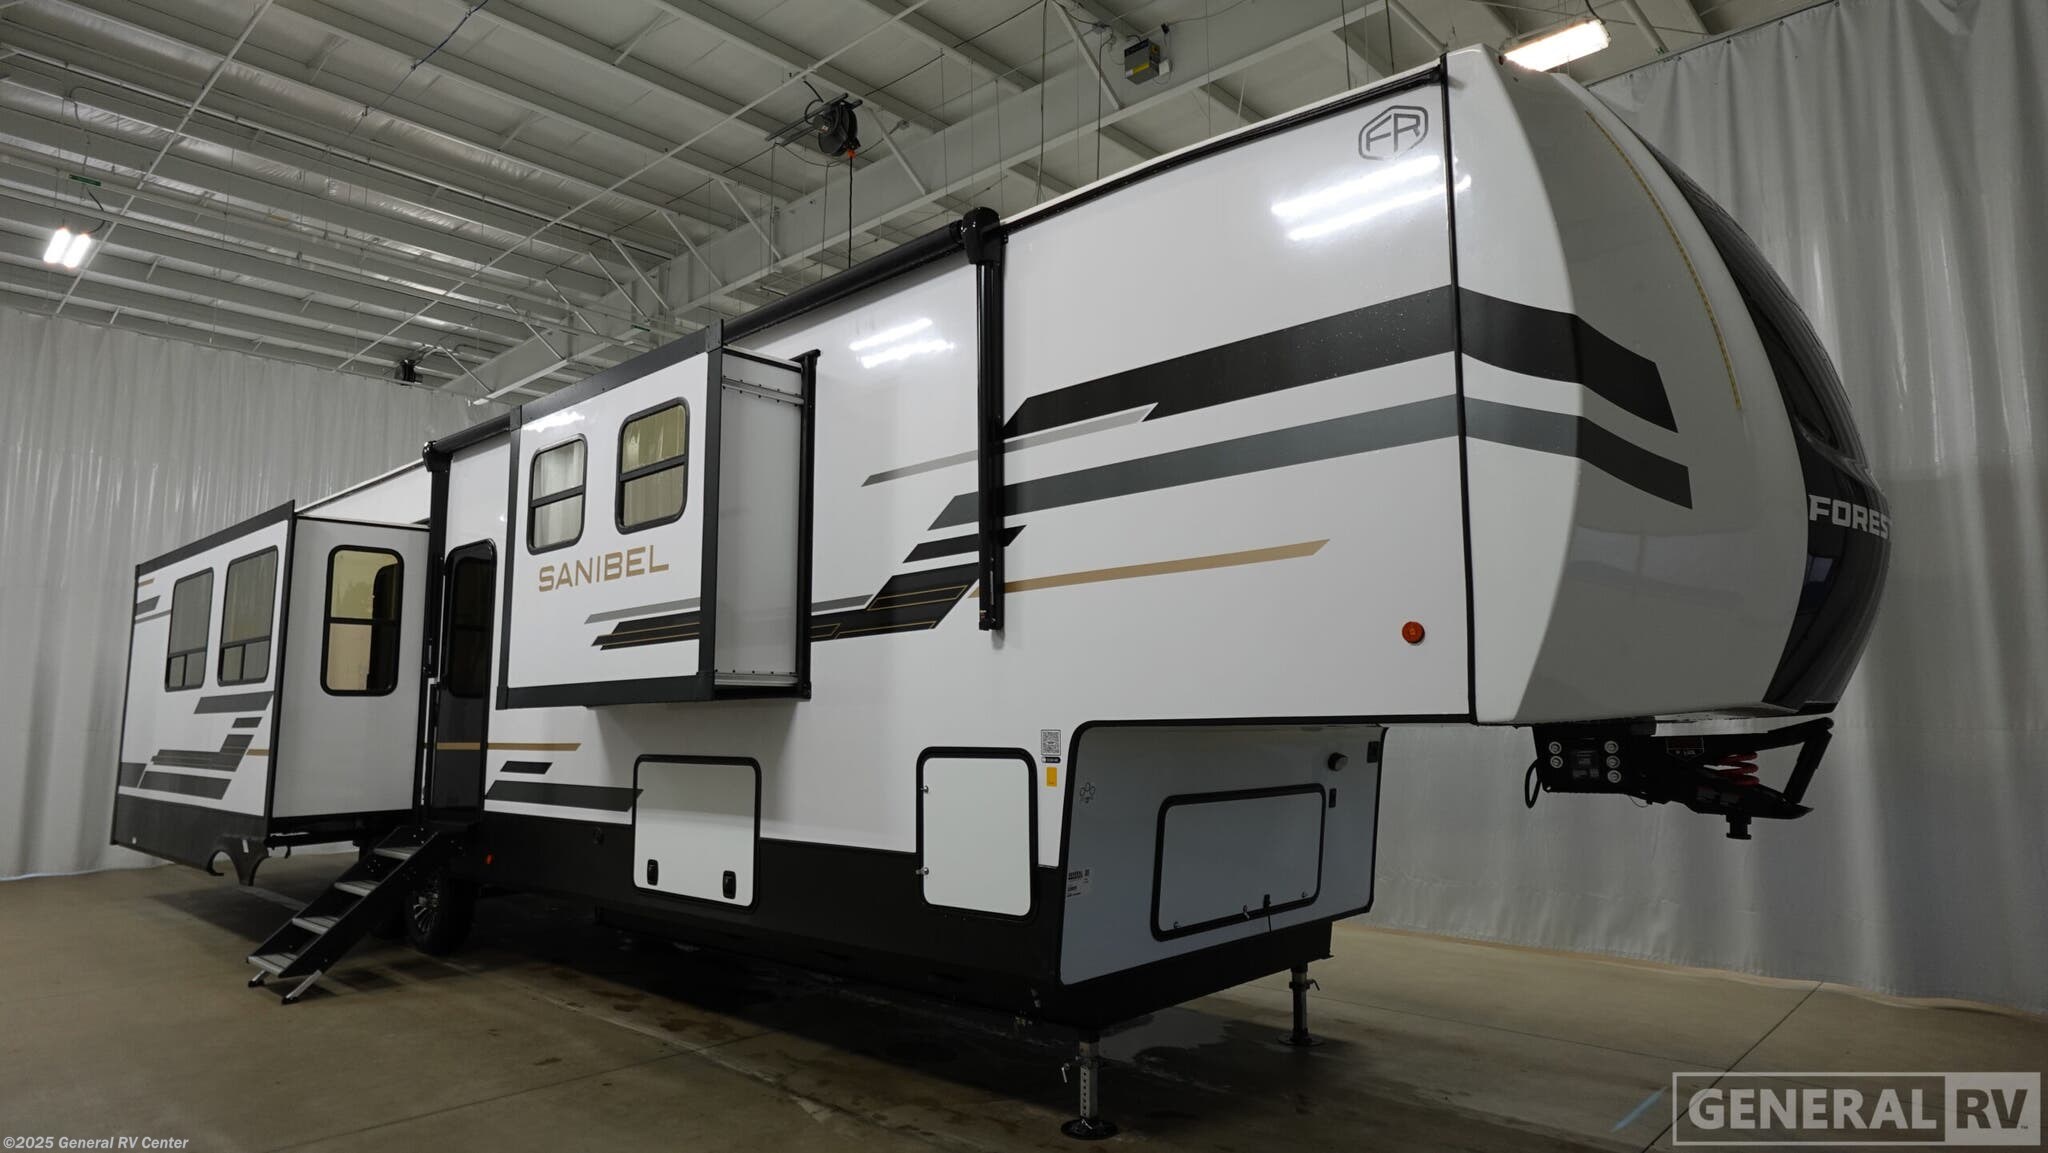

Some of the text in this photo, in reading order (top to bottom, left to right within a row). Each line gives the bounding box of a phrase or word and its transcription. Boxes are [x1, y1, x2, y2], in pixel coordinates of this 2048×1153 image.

[1366, 113, 1420, 152] FR
[1808, 494, 1893, 540] FORES
[538, 545, 669, 592] SANIBEL
